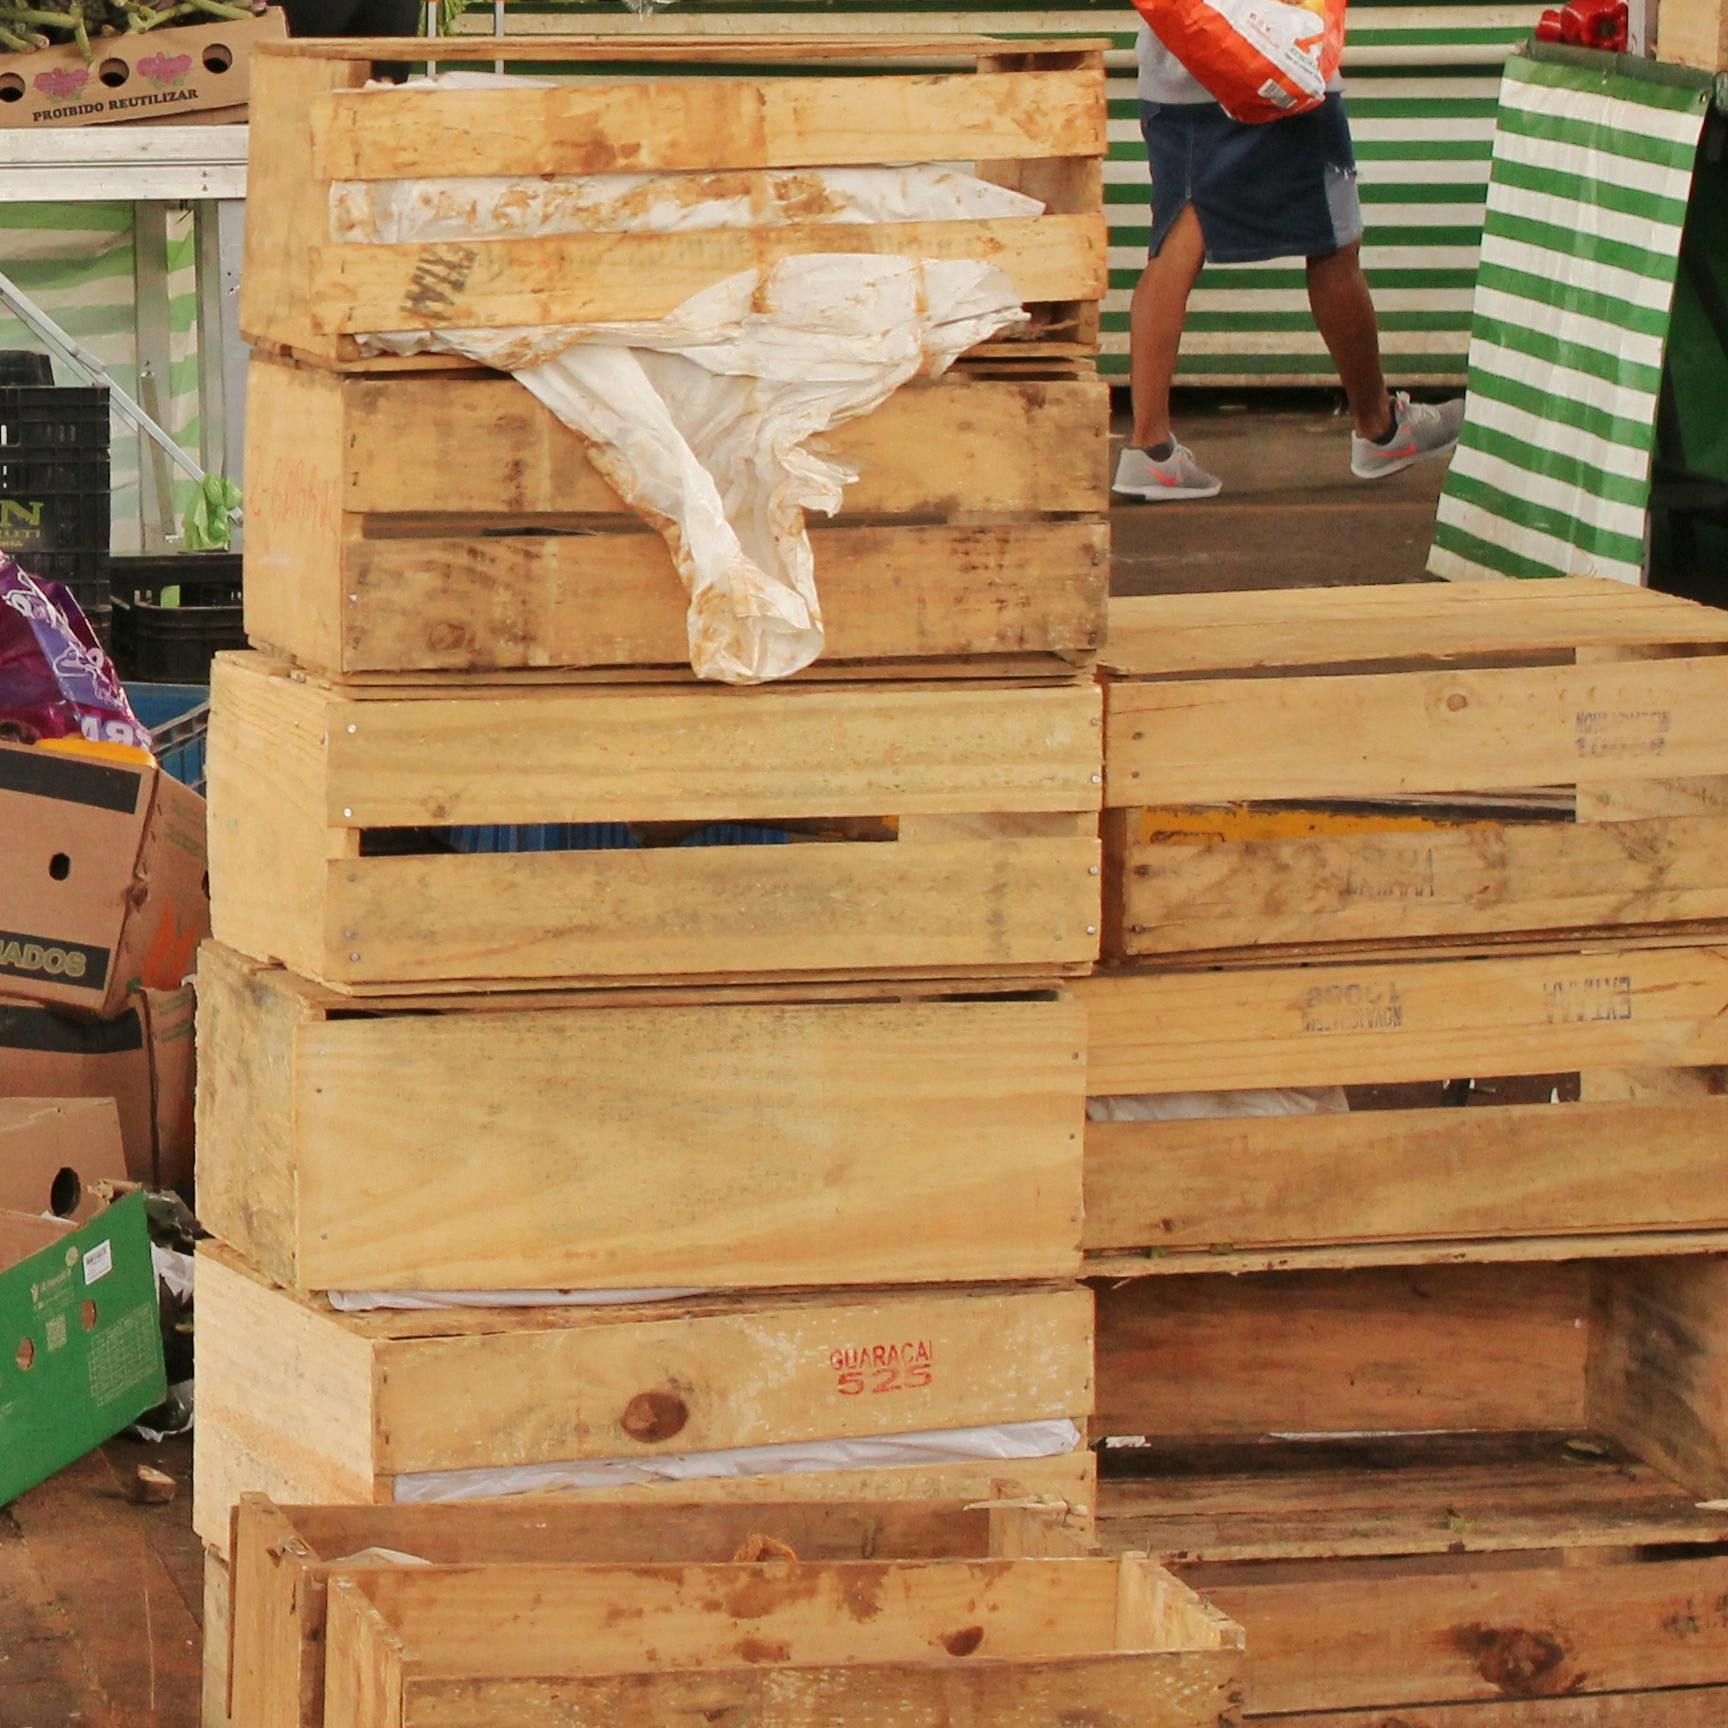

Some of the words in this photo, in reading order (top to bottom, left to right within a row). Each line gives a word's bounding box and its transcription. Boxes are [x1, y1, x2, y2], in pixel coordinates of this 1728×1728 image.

[32, 100, 105, 122] PROIBIDO
[107, 88, 200, 112] REUTILIZAR
[837, 1363, 934, 1396] 525
